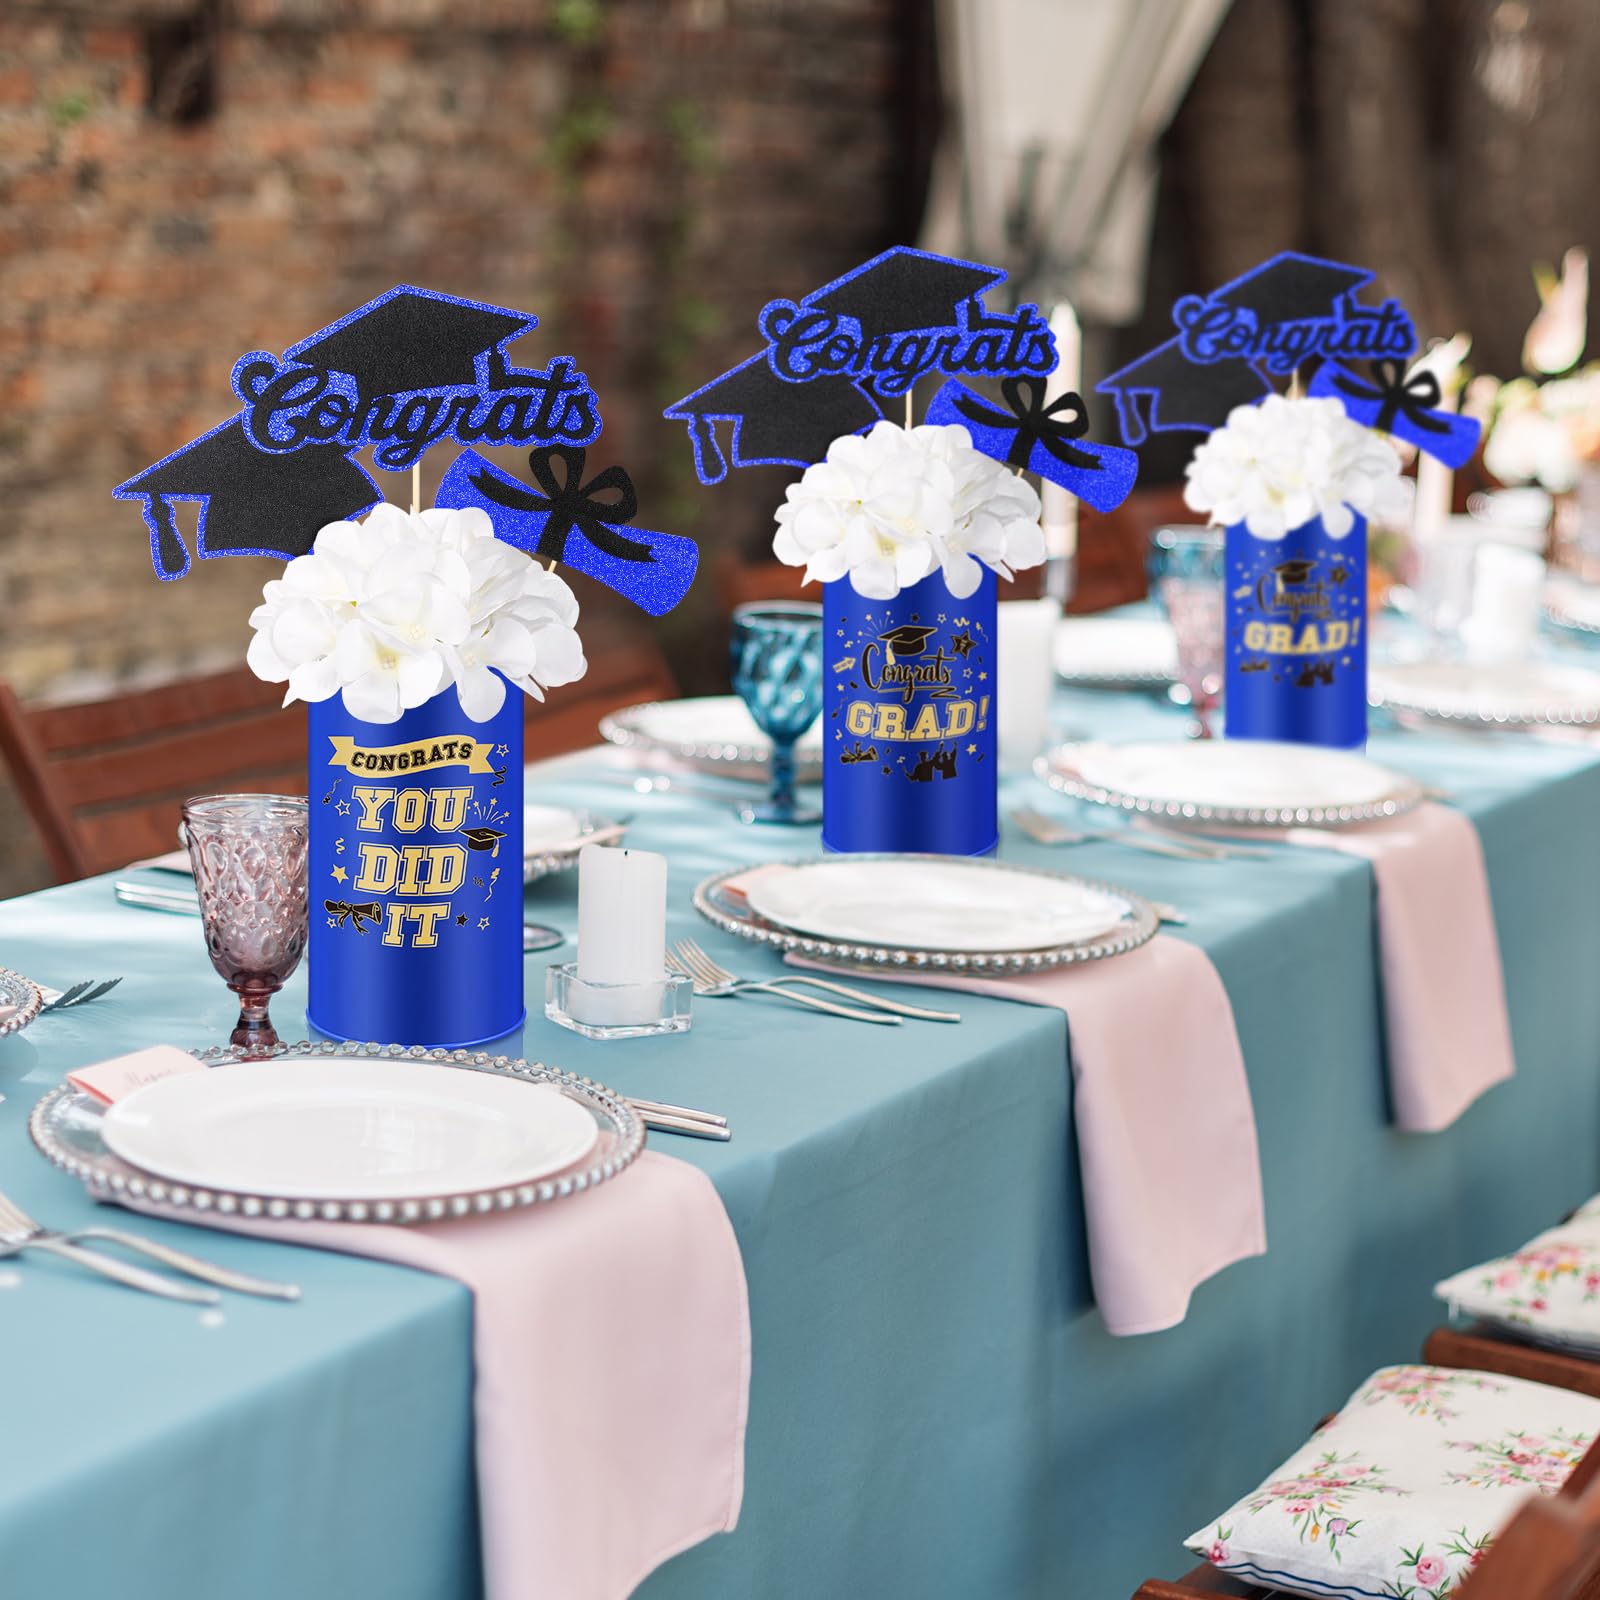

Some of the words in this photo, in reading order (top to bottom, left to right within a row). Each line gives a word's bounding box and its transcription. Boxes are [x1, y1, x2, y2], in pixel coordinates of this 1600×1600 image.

[765, 307, 1054, 392] Congrats
[1180, 302, 1415, 369] Congrats
[238, 360, 598, 466] Congrats
[1244, 617, 1360, 654] GRAD!
[861, 643, 956, 704] Congrats
[845, 695, 990, 742] GRAD!
[350, 741, 474, 772] CONGRATS
[352, 786, 474, 833] YOU
[353, 842, 468, 896] DID
[382, 902, 451, 948] IT
